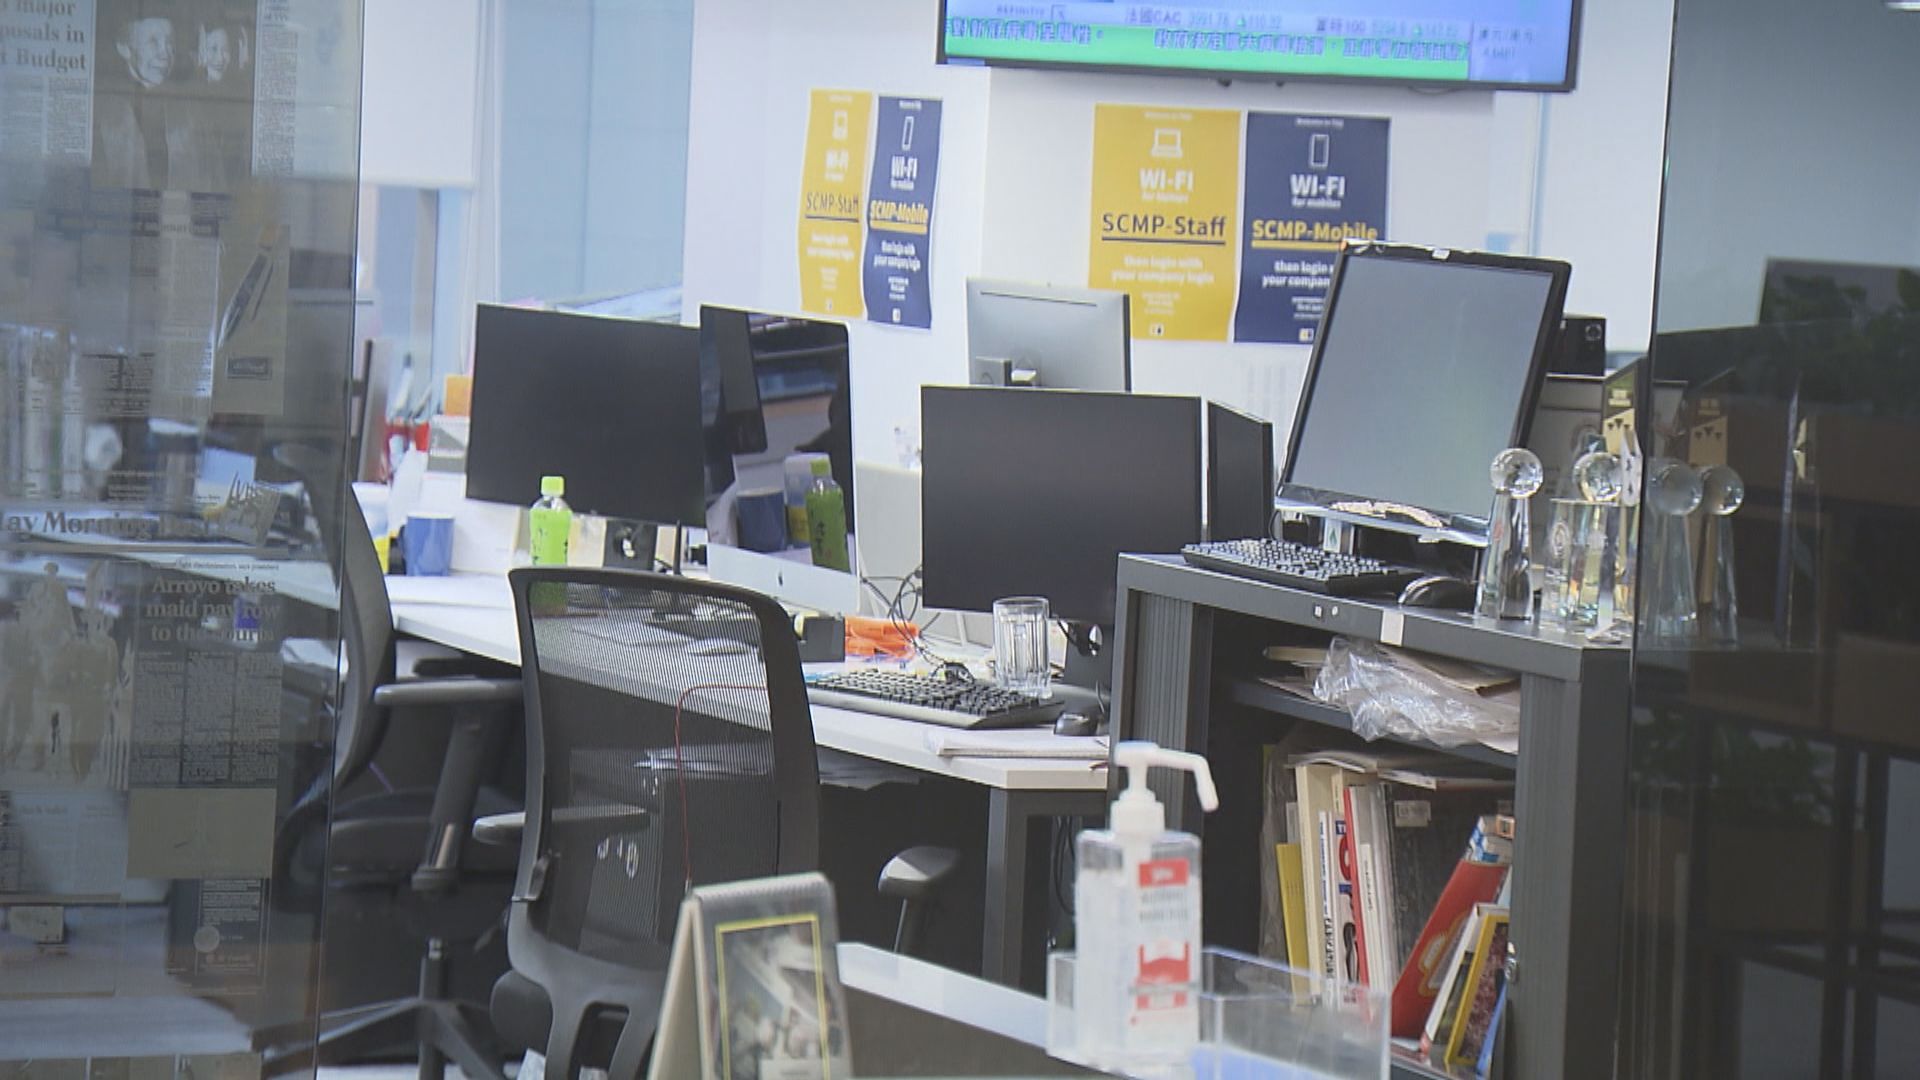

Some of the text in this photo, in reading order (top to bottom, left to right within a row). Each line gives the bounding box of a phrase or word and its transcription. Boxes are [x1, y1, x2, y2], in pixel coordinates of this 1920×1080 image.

[16, 0, 76, 18] major
[66, 24, 85, 43] in
[16, 48, 86, 74] Budget
[1140, 167, 1194, 192] WI-FI
[1290, 174, 1345, 198] WI-FI
[806, 192, 859, 214] SCMP-Staff
[870, 200, 928, 224] SCMP-Mobile
[1102, 213, 1226, 237] SCMP-Staff
[1252, 219, 1378, 240] SCMP-Mobile
[1274, 260, 1300, 272] then
[1302, 261, 1328, 276] login
[1262, 275, 1331, 289] your compan
[43, 511, 152, 542] Morning
[152, 576, 220, 600] Arroyo
[145, 598, 280, 622] maid pay row
[152, 624, 171, 642] to
